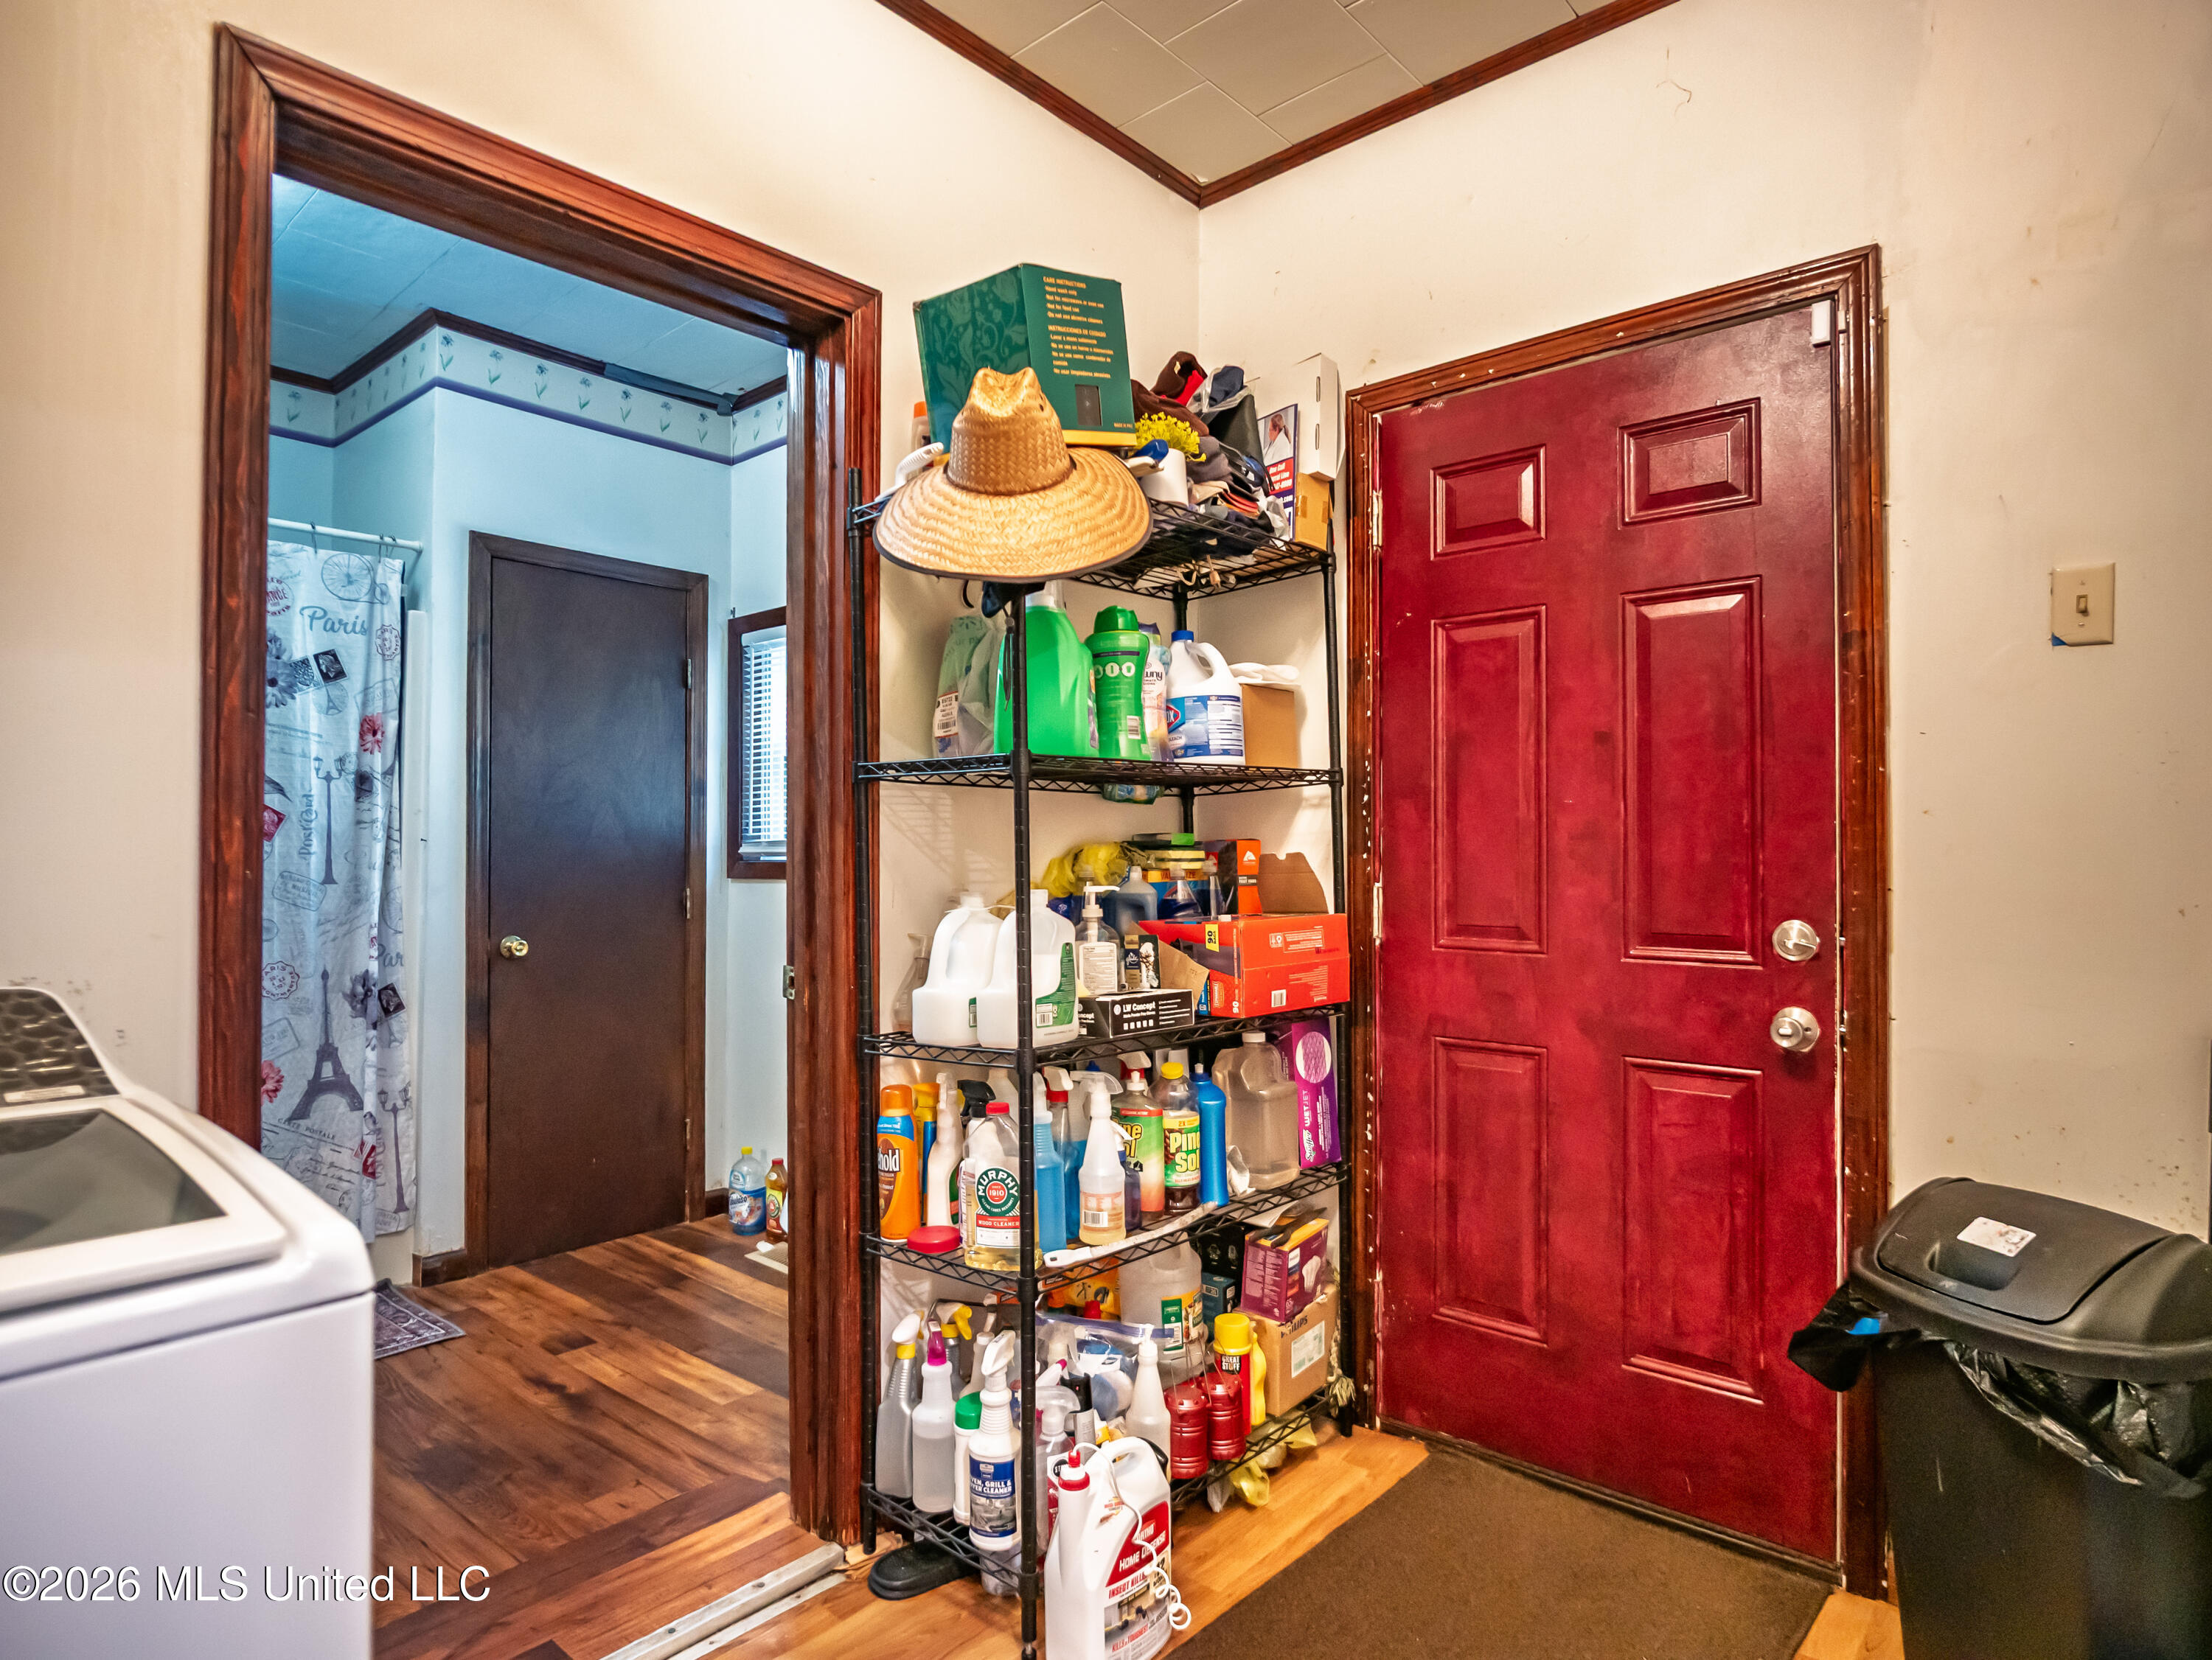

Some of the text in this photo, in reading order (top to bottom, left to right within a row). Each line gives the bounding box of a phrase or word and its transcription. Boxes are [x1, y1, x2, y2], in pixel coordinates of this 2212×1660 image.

[299, 605, 367, 635] Paris
[1133, 1001, 1155, 1012] Concept
[978, 1170, 1018, 1196] MURPHY
[1222, 1355, 1240, 1364] GREAT
[1222, 1362, 1240, 1370] STUFF
[983, 1486, 1012, 1494] CLEANER
[1119, 1551, 1140, 1572] HOME
[1108, 1580, 1130, 1599] INSECT
[1130, 1570, 1148, 1588] KILLE
